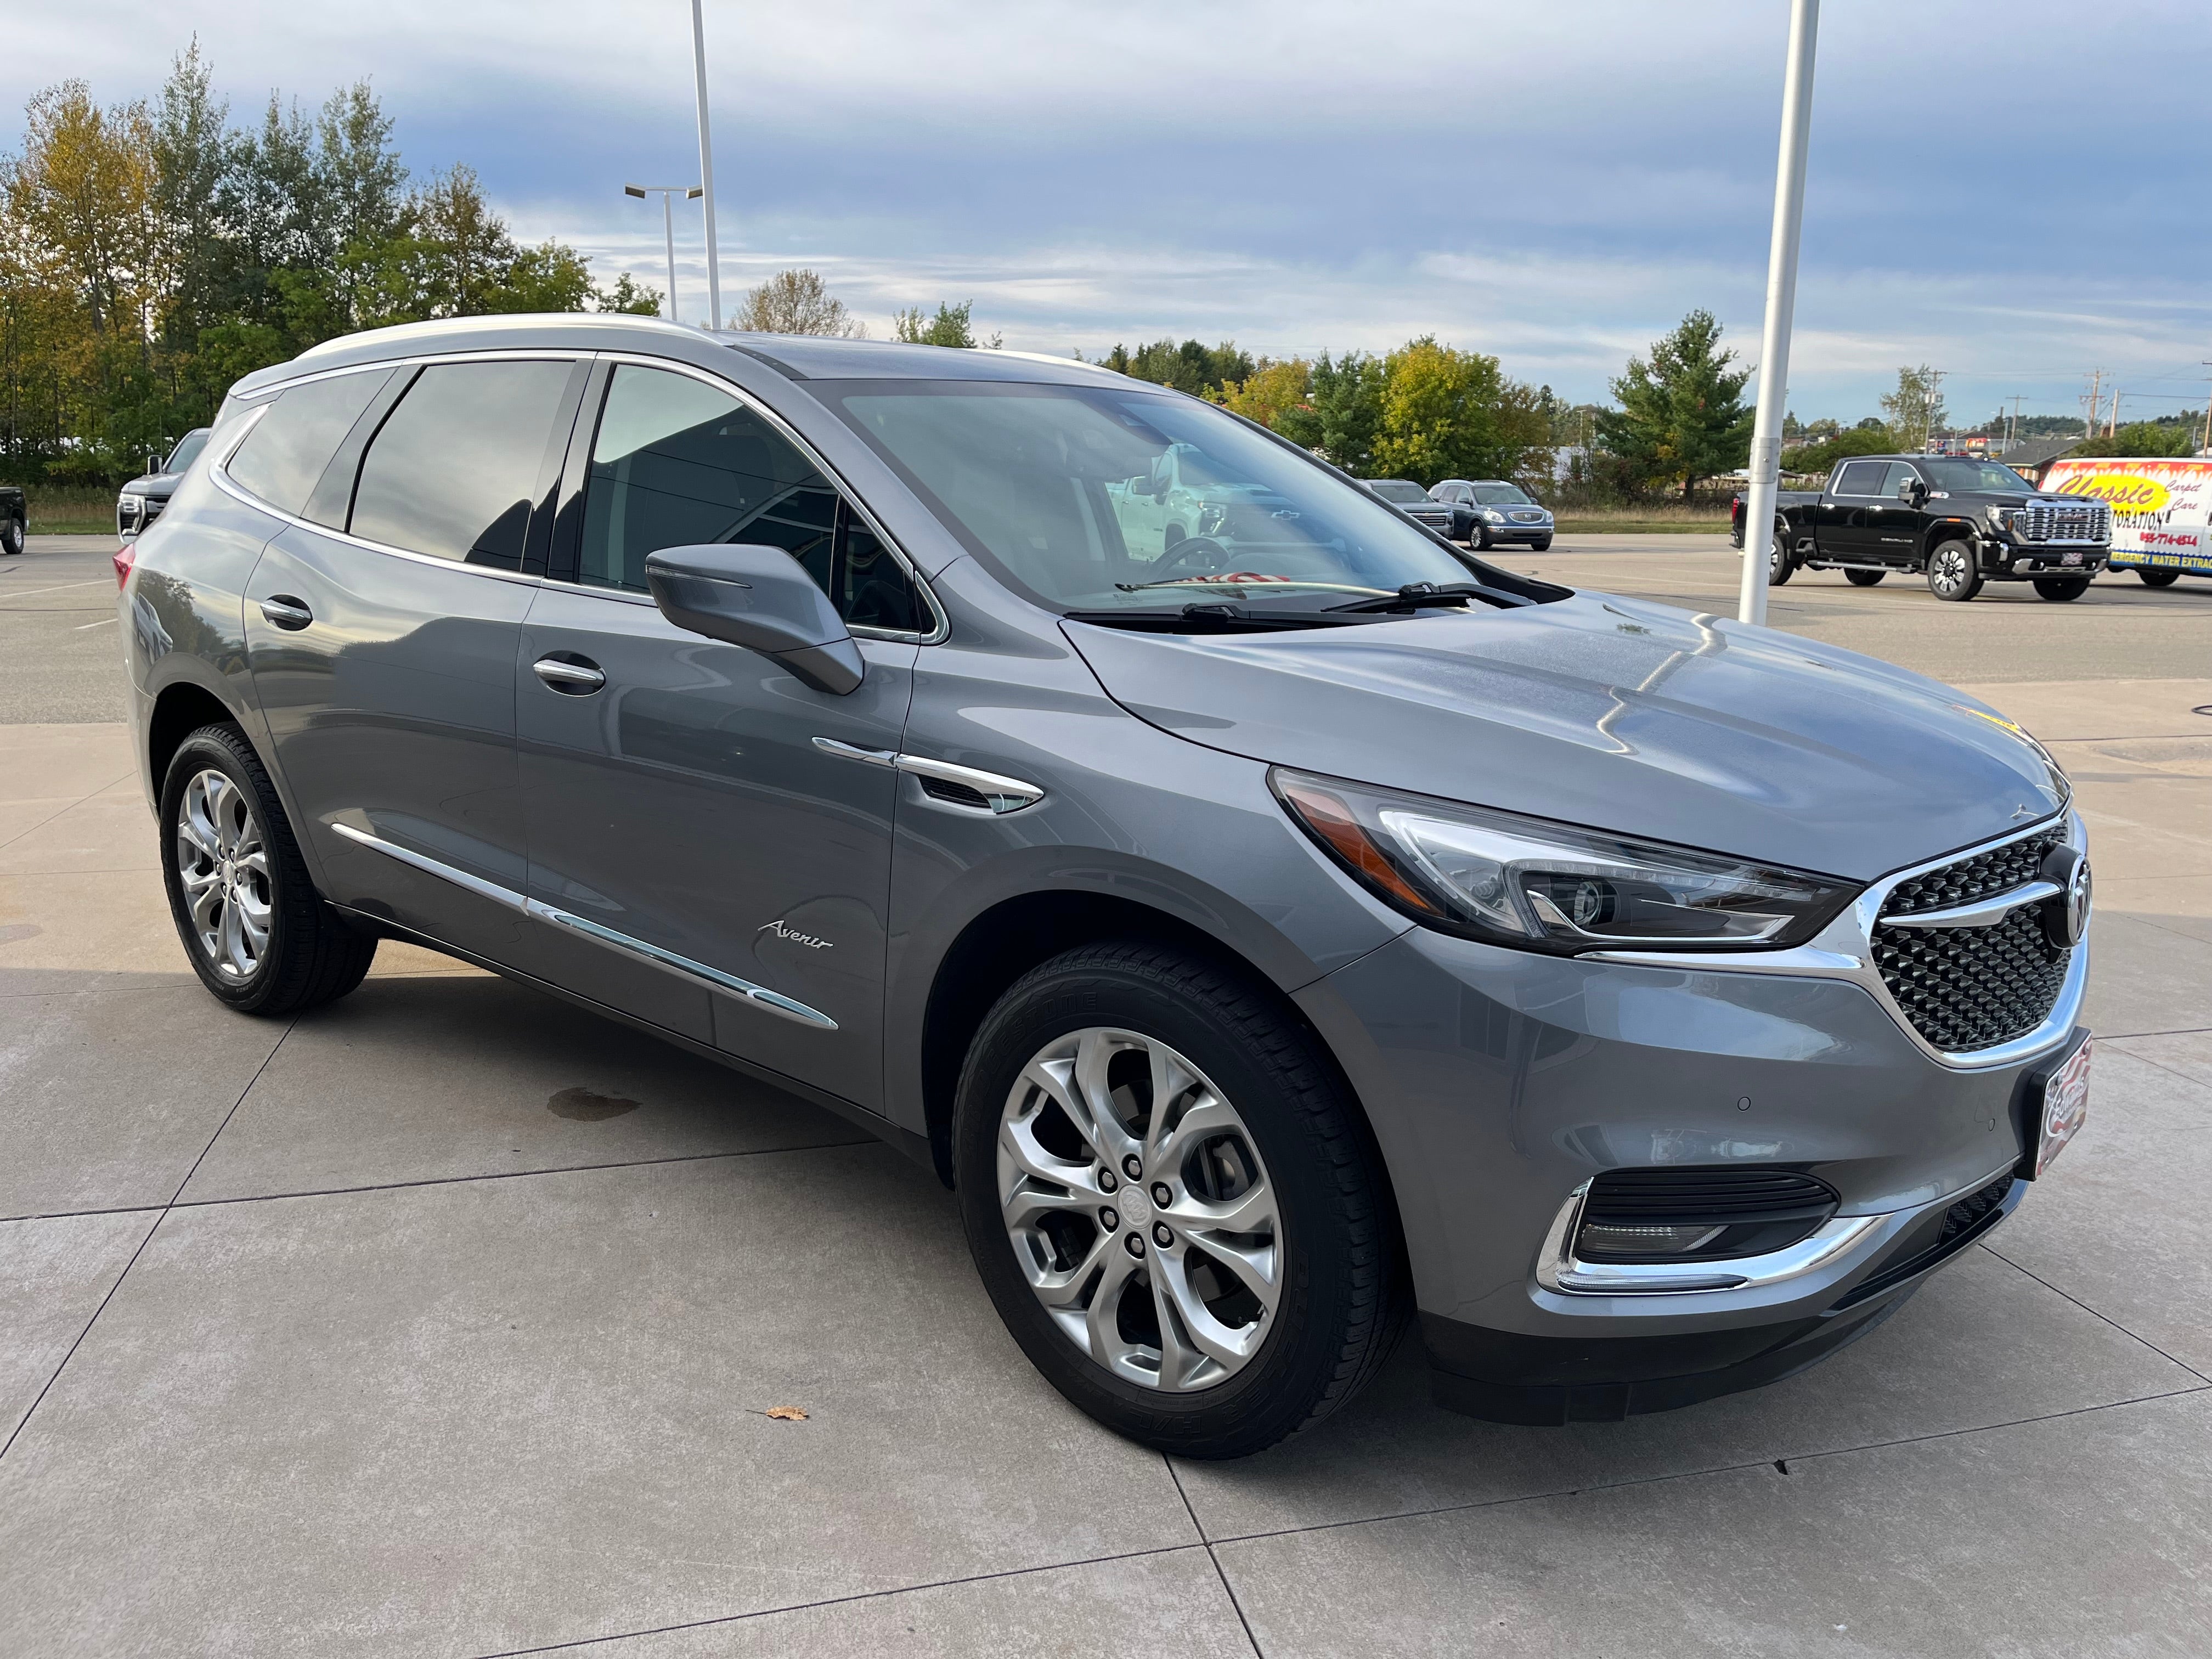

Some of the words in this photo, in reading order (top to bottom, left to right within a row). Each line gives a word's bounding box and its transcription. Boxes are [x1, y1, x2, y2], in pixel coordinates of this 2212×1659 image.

[2055, 474, 2154, 505] Classic
[2164, 480, 2202, 493] Carpet
[2171, 498, 2198, 511] Care
[2152, 555, 2180, 566] WATER
[758, 920, 833, 949] Avenir
